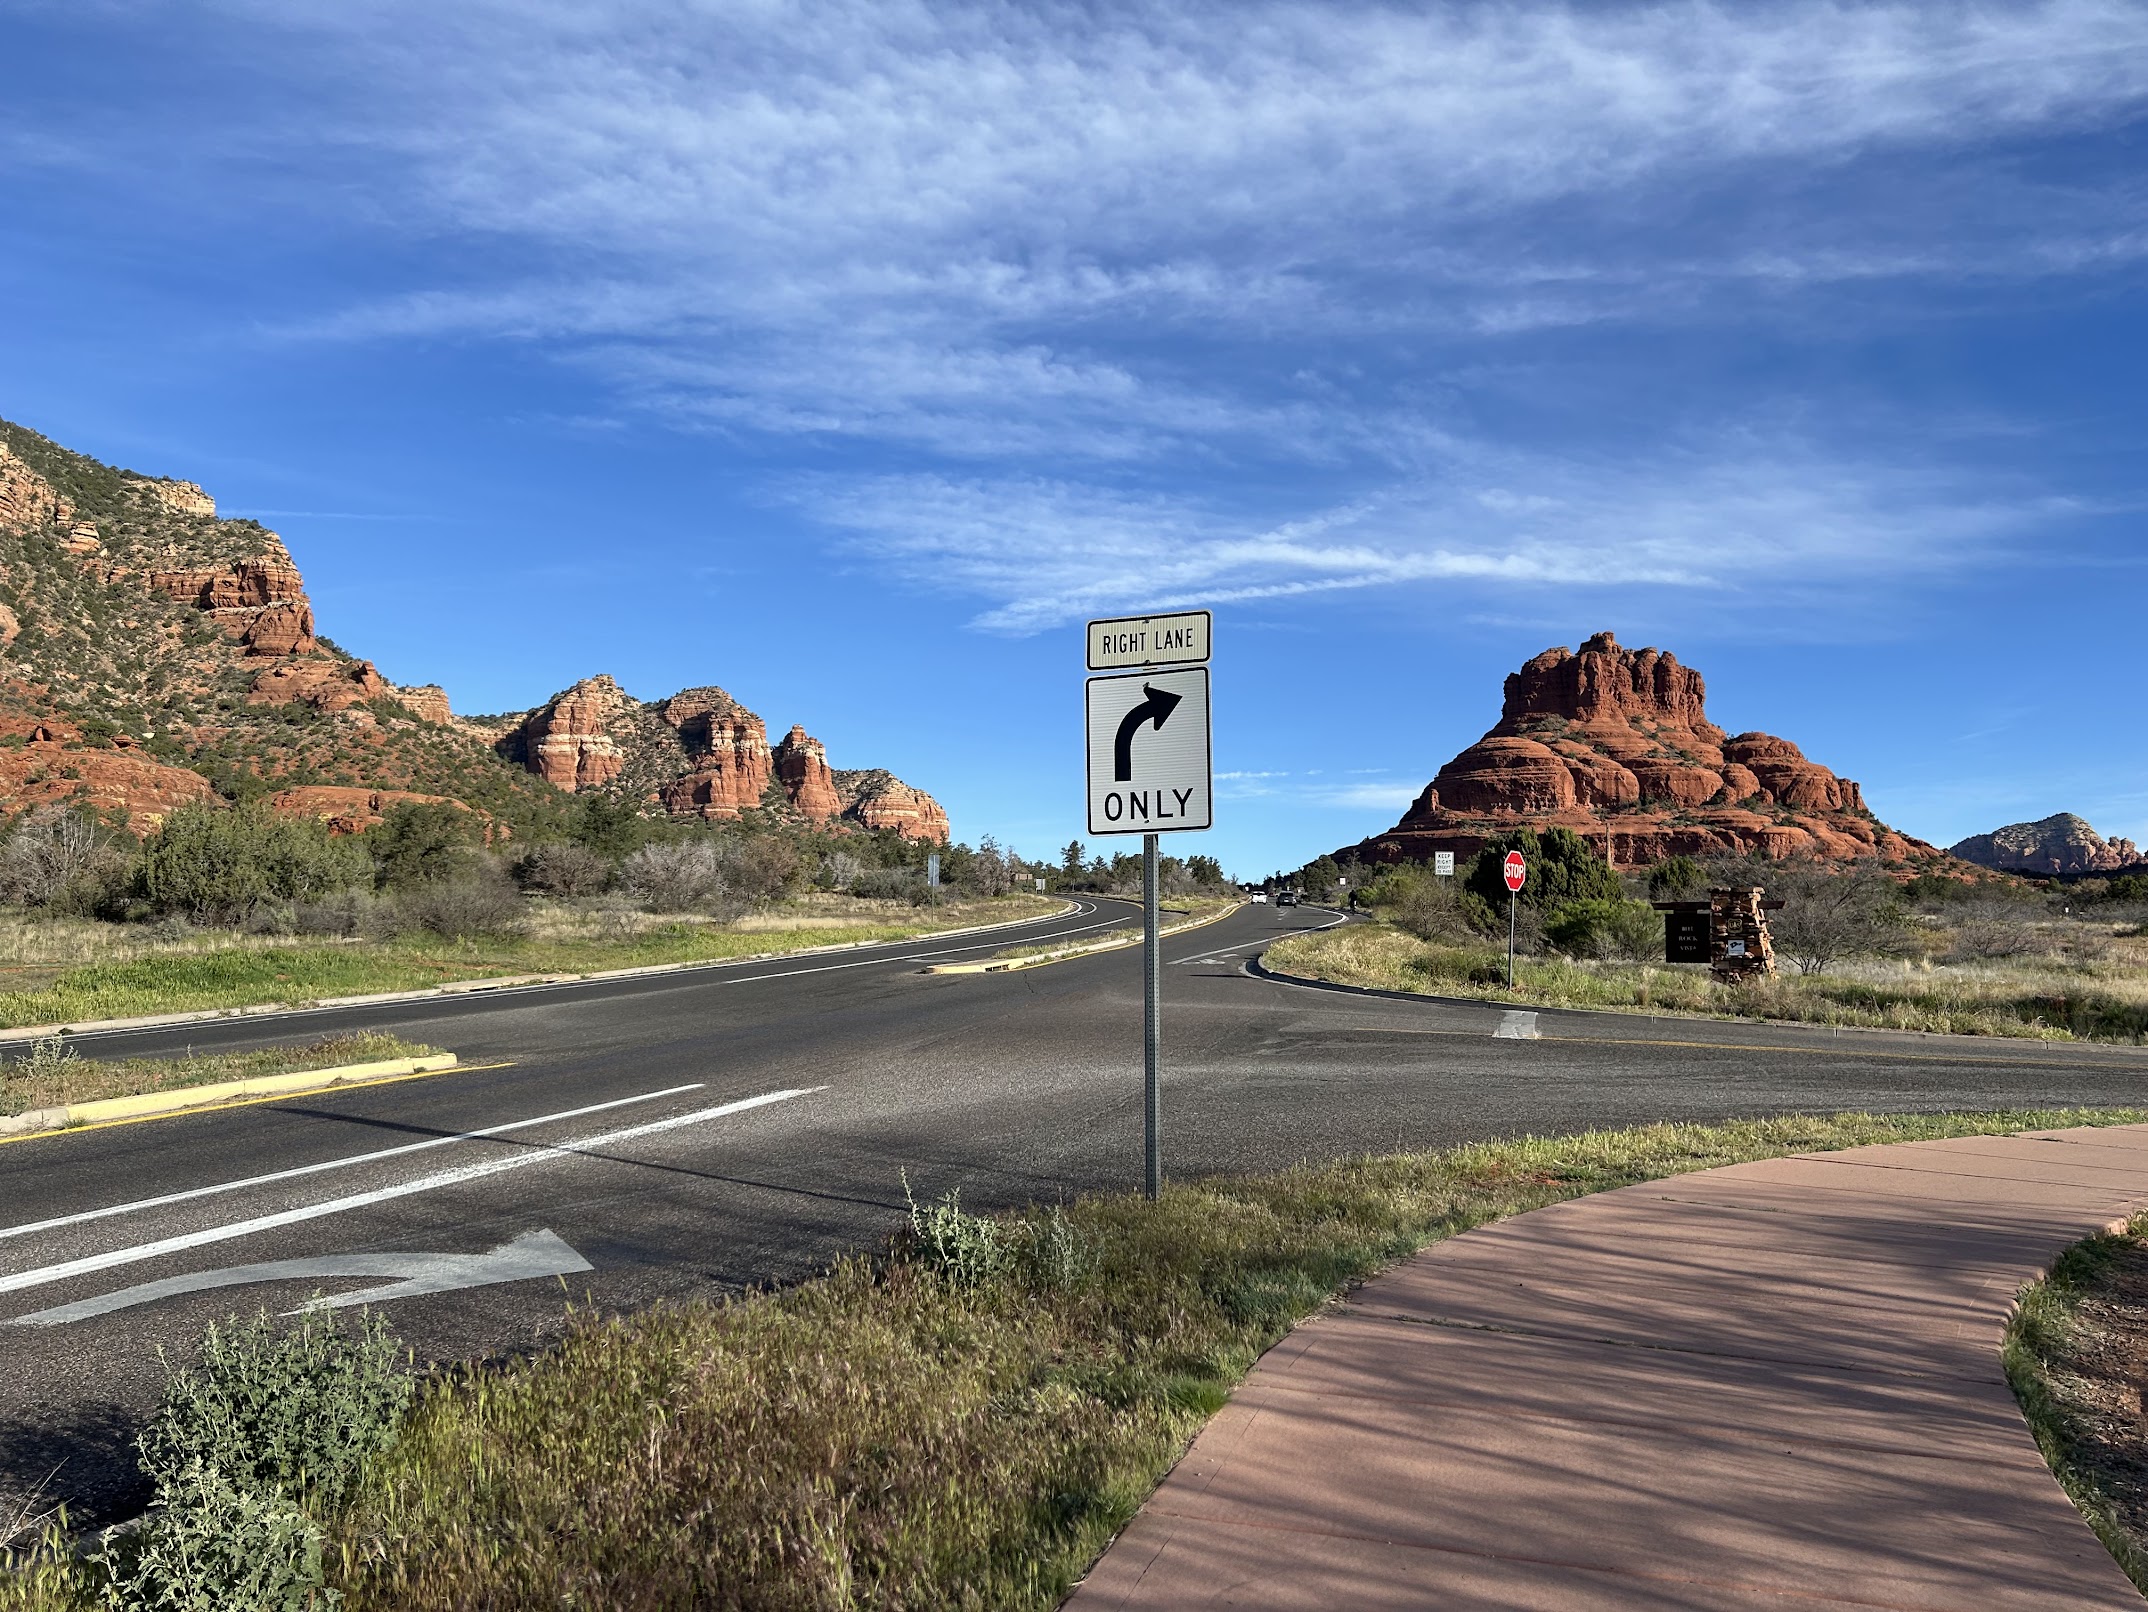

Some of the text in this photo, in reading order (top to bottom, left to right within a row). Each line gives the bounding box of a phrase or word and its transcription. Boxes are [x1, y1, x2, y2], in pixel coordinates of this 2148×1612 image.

[1103, 628, 1193, 654] RIGHT LANE
[1104, 788, 1194, 821] ONLY
[1505, 862, 1524, 879] STOP
